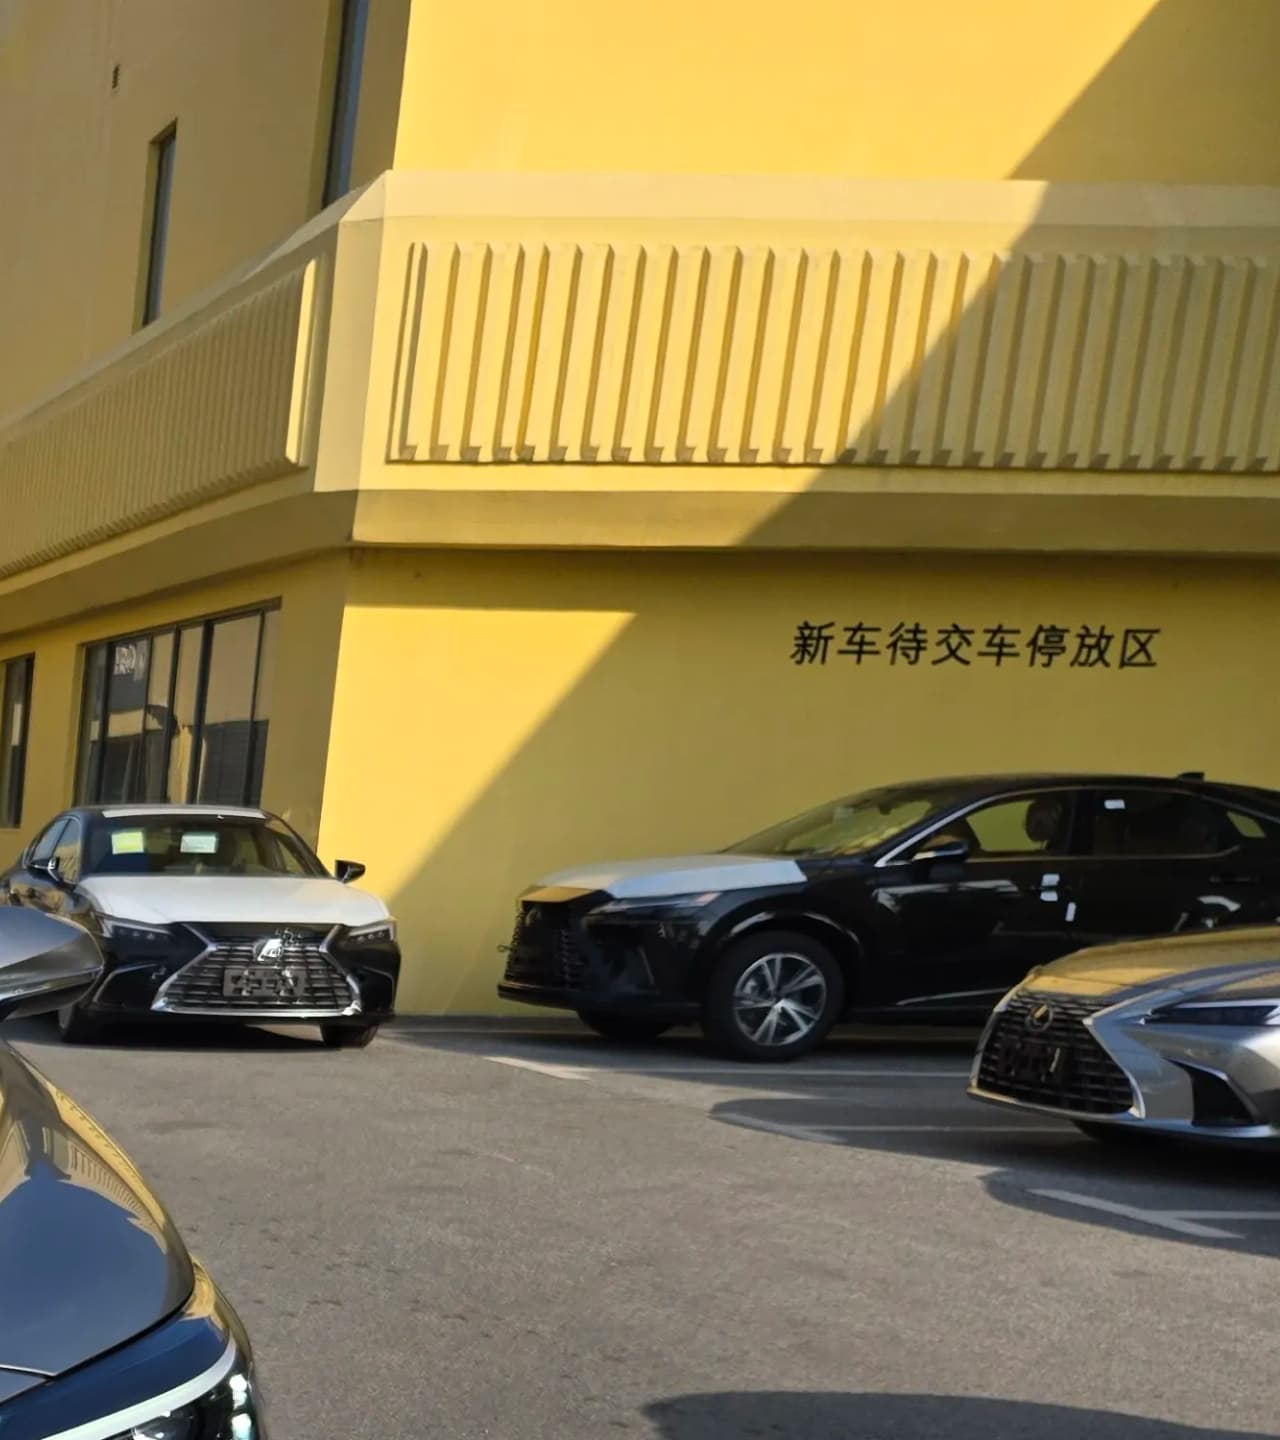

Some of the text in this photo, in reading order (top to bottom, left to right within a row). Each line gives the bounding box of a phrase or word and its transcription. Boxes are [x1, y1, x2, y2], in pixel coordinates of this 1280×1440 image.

[790, 620, 1161, 669] 新车待交车停放区
